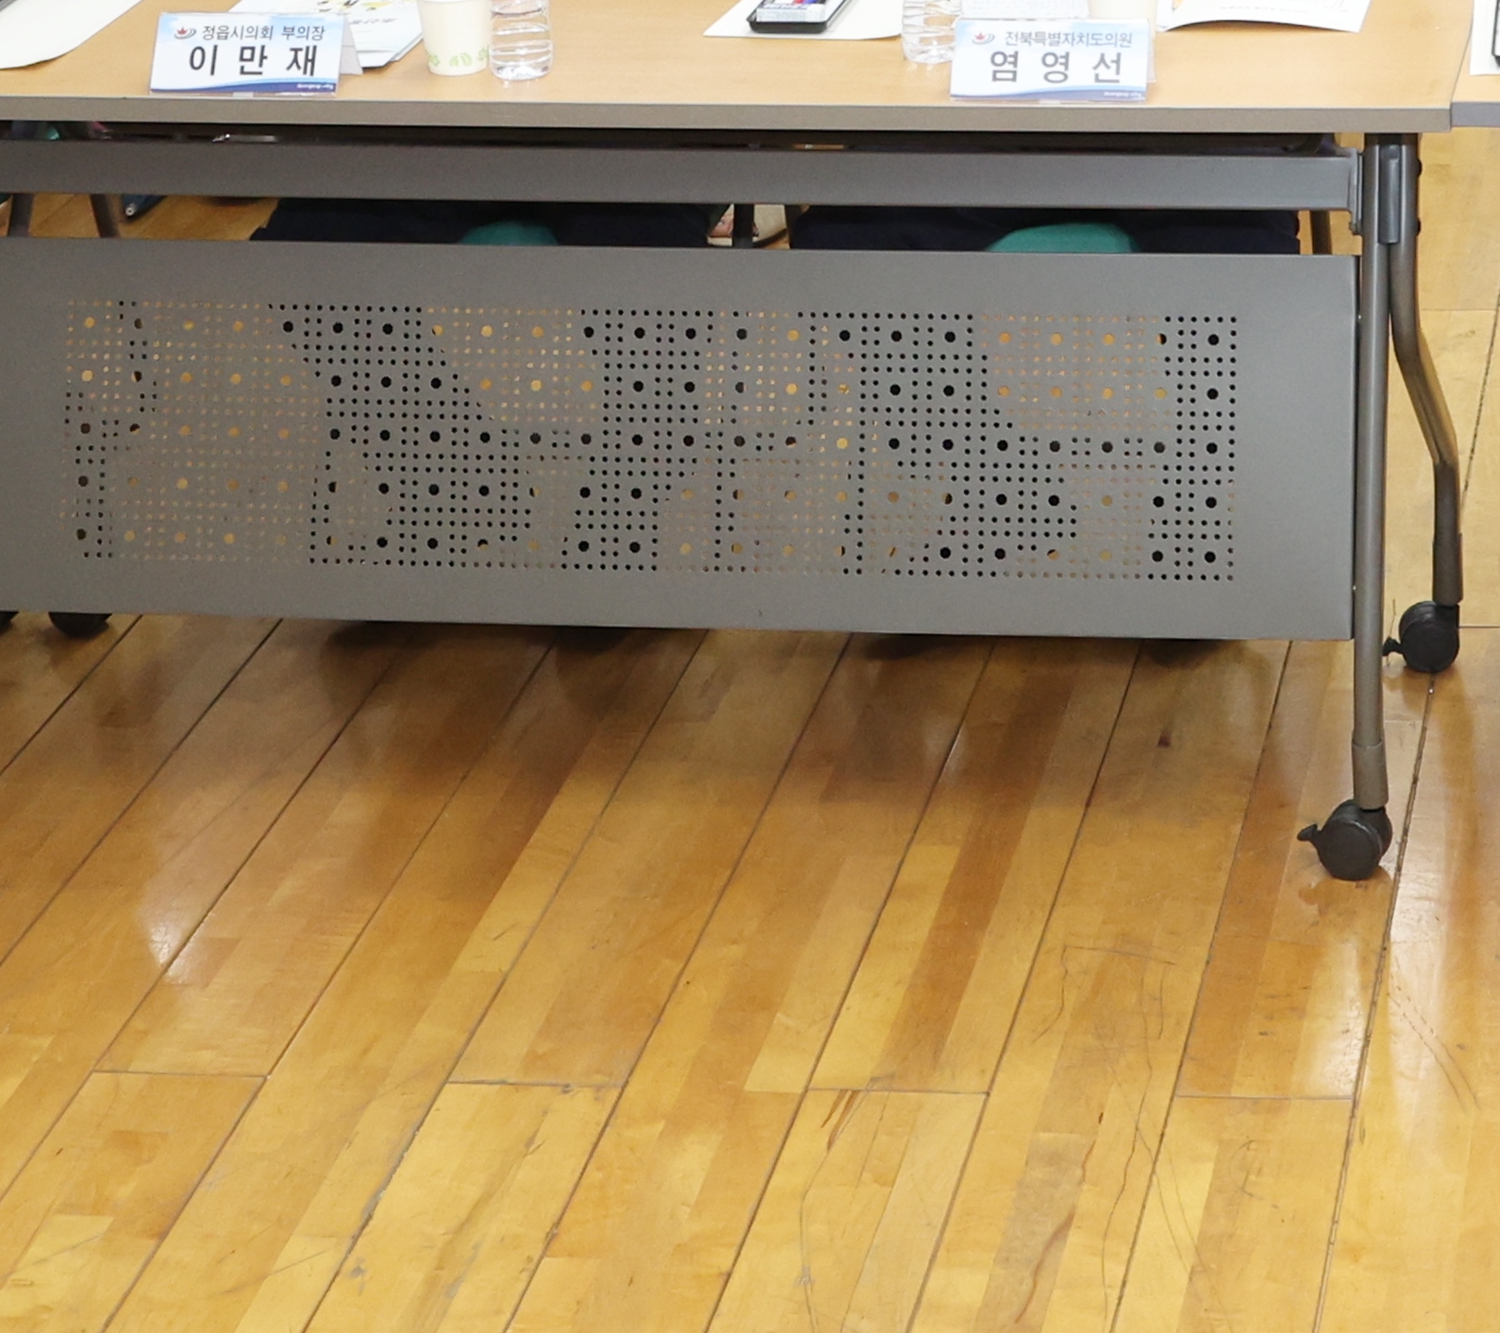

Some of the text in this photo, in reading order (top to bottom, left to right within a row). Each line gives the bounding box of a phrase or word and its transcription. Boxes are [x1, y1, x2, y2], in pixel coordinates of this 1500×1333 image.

[202, 25, 325, 41] 정읍시의회 부의장
[1005, 31, 1133, 48] 전북특별자치도의원
